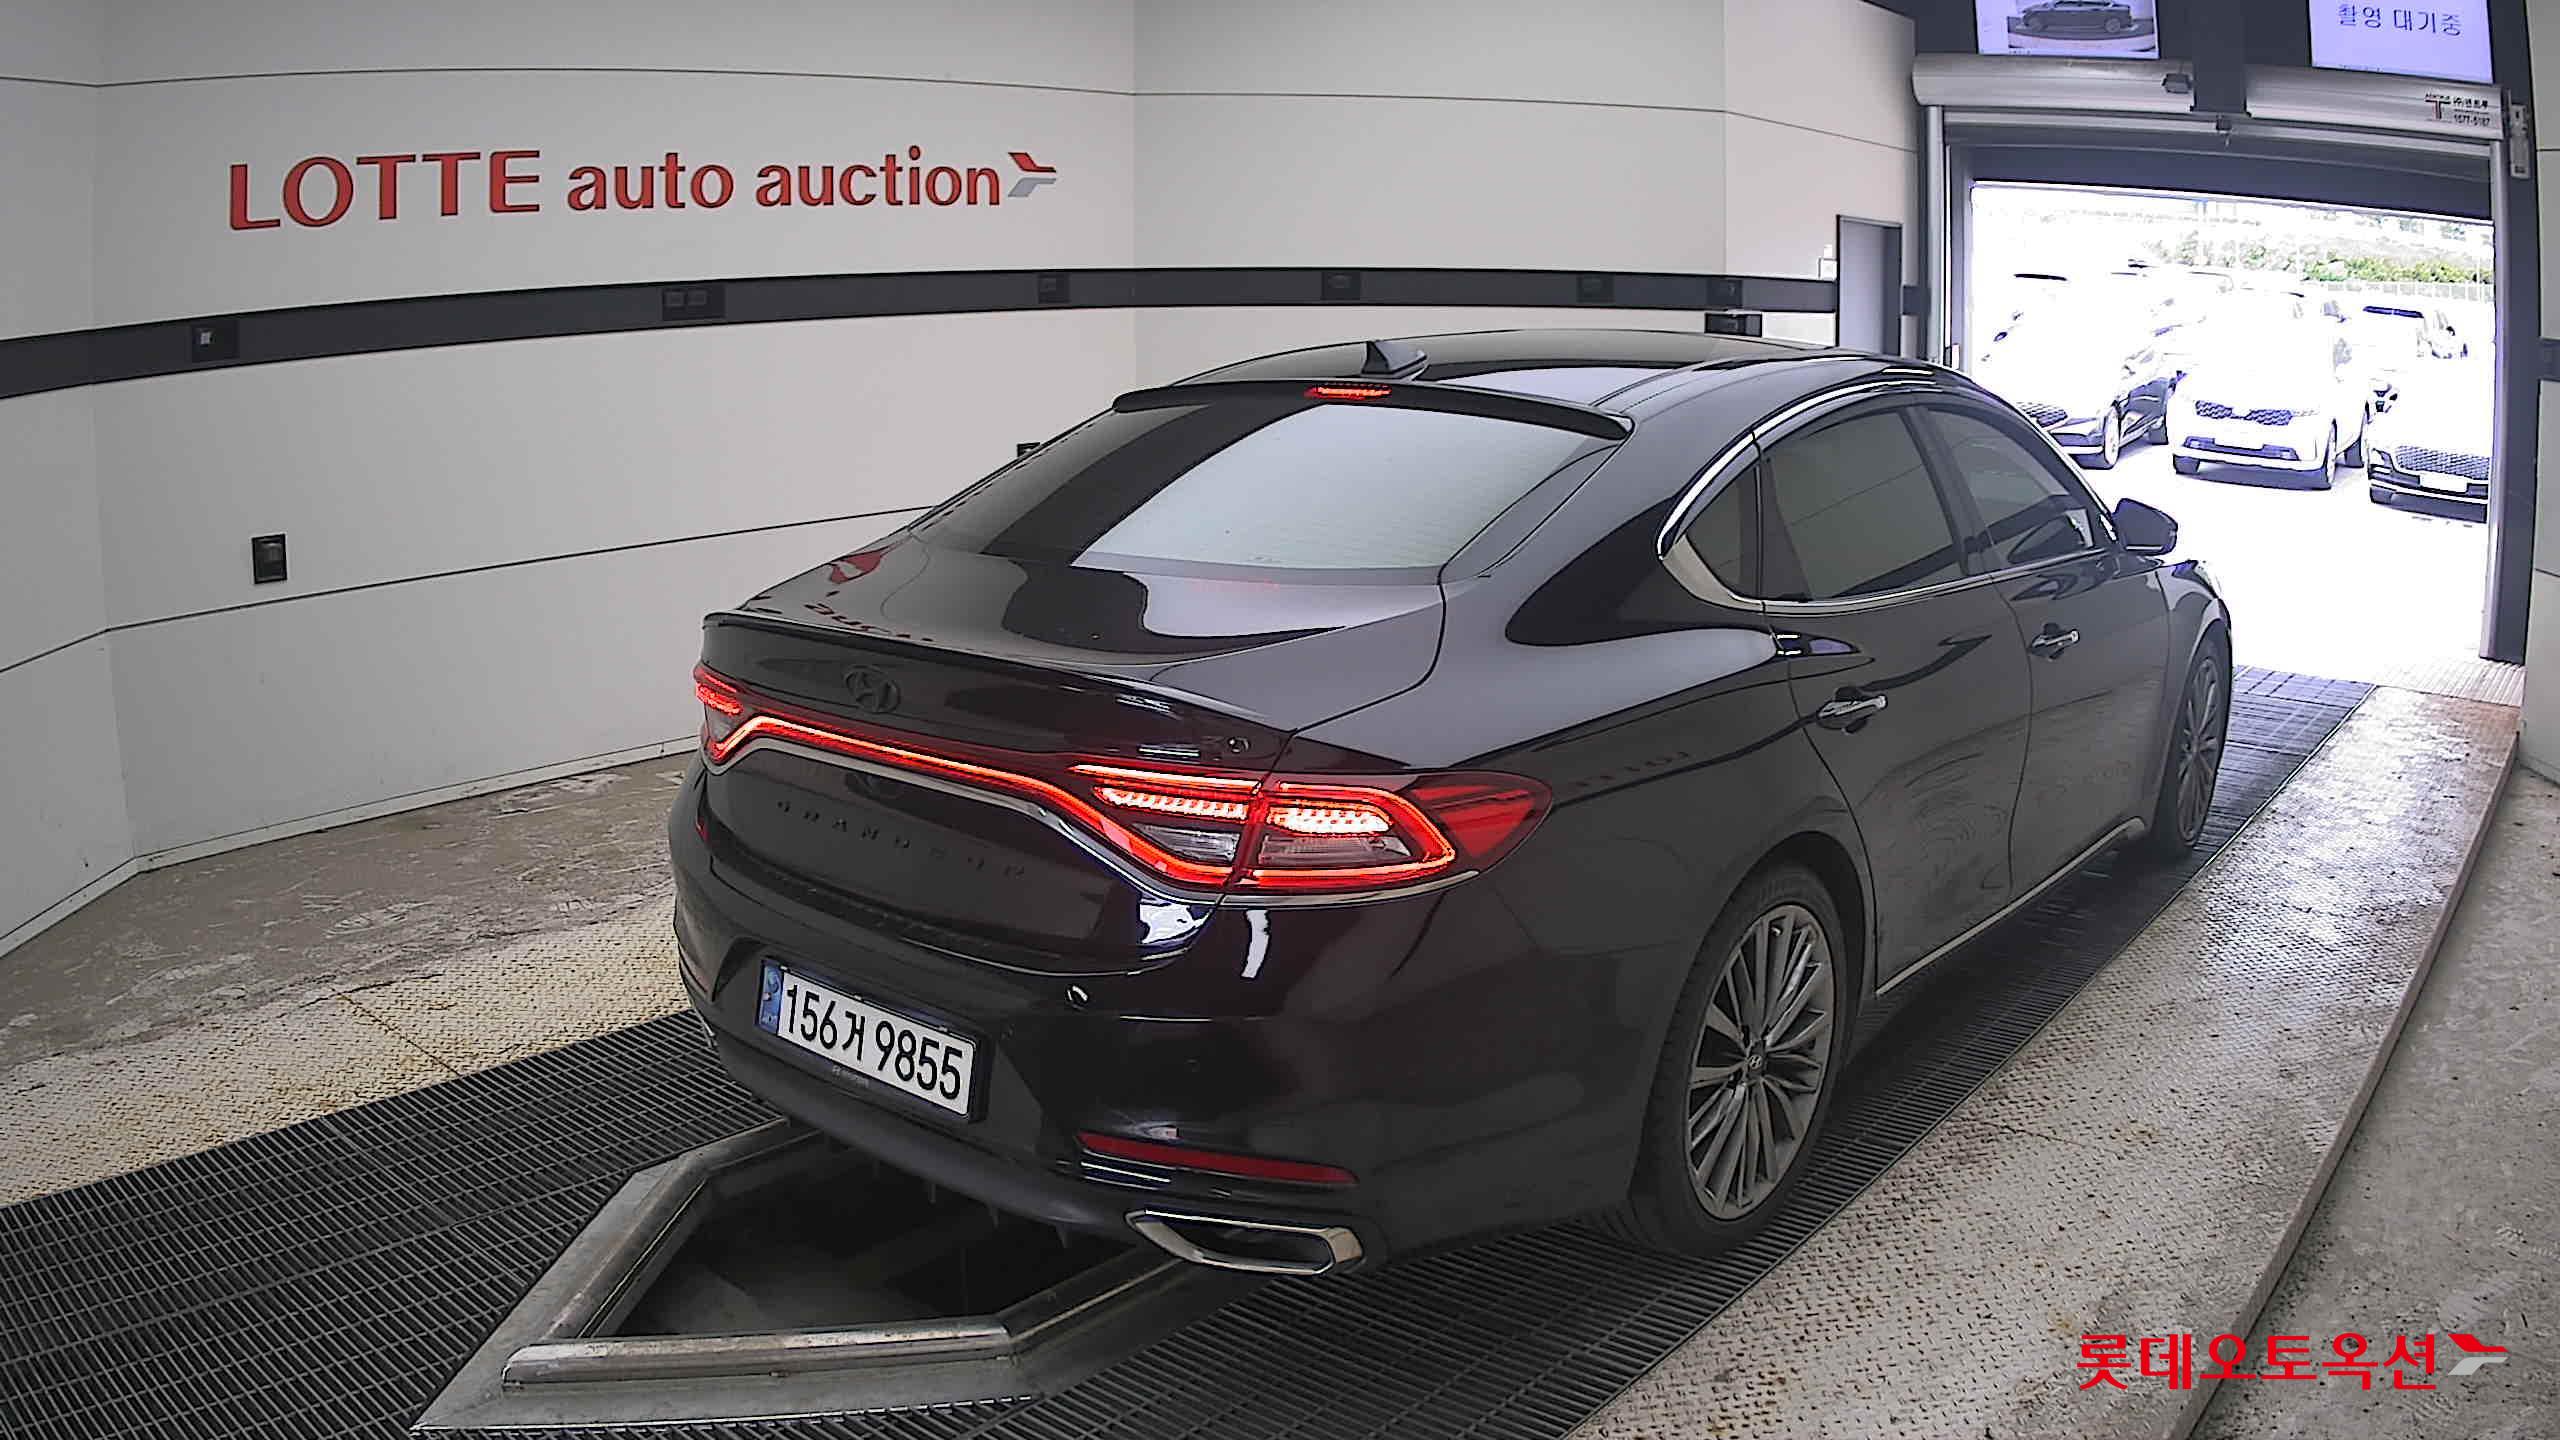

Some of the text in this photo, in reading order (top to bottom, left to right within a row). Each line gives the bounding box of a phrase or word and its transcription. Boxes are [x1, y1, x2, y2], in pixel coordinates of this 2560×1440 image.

[2338, 4, 2462, 37] 촬영 대기중
[229, 145, 1001, 231] LOTTE auto auction
[786, 983, 963, 1101] 156거 9855
